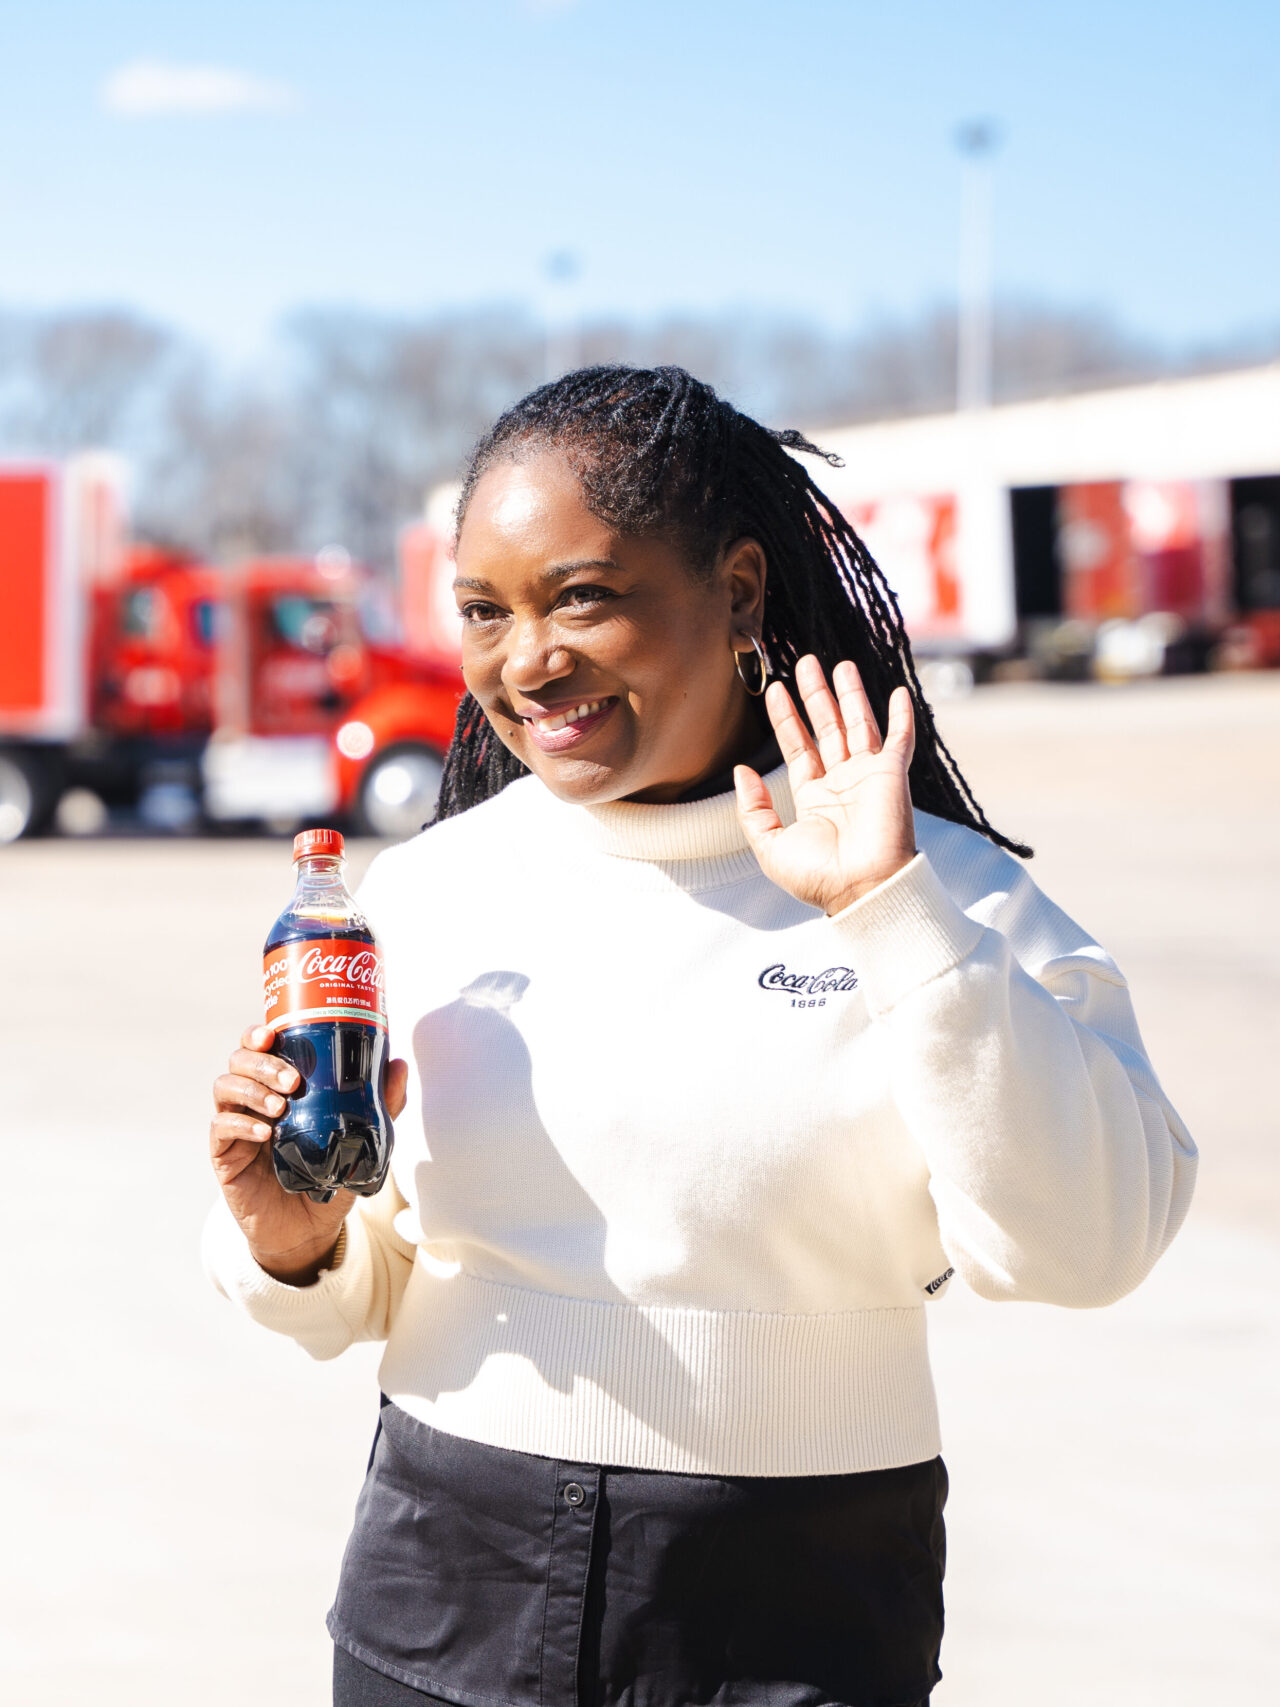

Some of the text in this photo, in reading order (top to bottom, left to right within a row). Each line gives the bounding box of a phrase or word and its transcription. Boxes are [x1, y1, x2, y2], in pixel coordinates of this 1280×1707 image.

[297, 948, 385, 988] Coca-Cola
[758, 964, 858, 995] Coca-Cola
[357, 984, 375, 992] TASTE
